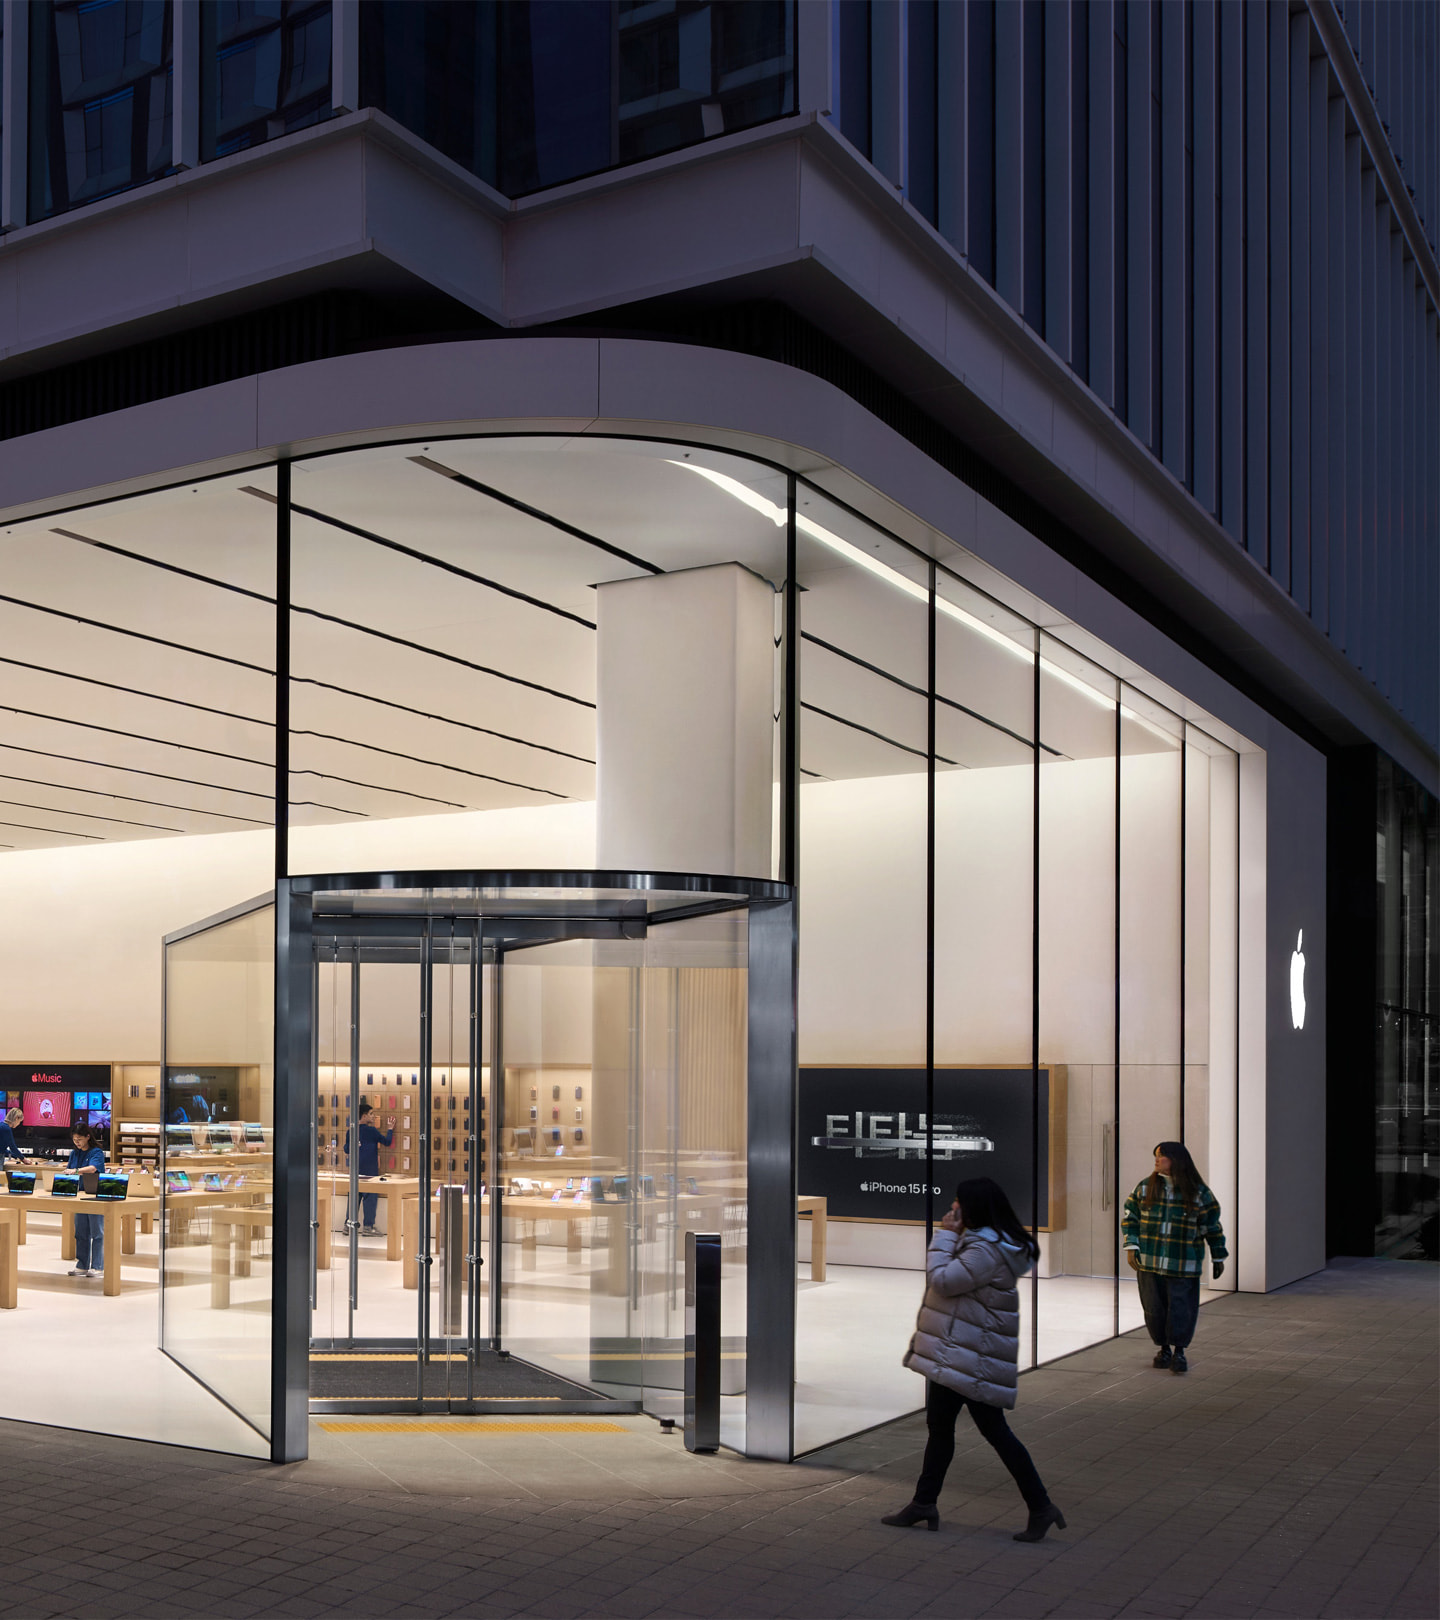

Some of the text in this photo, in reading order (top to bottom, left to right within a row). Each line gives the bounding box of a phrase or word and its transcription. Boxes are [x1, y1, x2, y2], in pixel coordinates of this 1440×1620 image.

[38, 1073, 62, 1083] Music
[869, 1182, 907, 1193] iPhone
[908, 1183, 921, 1194] 15
